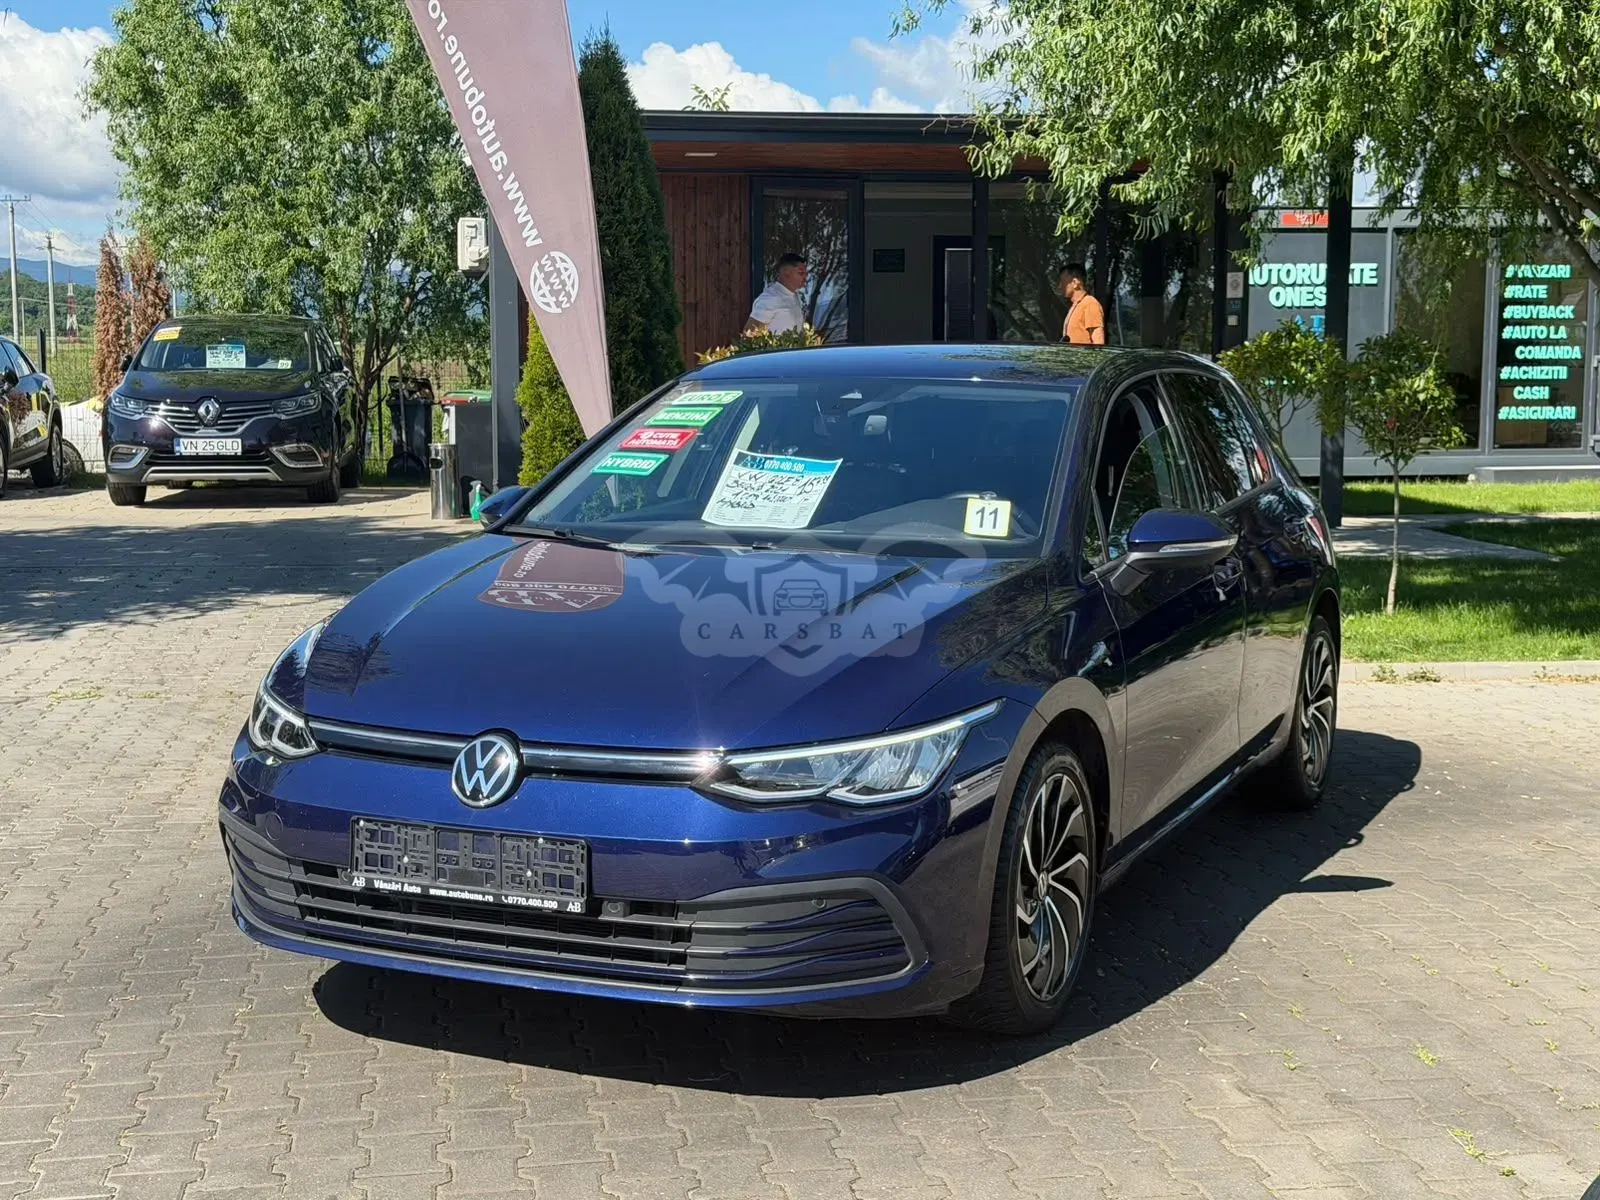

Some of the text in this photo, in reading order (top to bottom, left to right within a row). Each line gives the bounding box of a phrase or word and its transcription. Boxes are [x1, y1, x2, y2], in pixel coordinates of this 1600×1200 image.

[1248, 263, 1379, 285] UTORUTE
[1503, 285, 1549, 299] #RATE
[1502, 305, 1576, 319] #BUYBACK
[1501, 325, 1568, 340] #AUTO LA
[1514, 345, 1582, 360] COMANDA
[1499, 365, 1568, 380] #ACHIZITII
[1513, 386, 1551, 400] CASH
[1497, 406, 1577, 420] #ASIGURARI
[182, 440, 240, 451] VN 25 GLD
[602, 457, 658, 470] HYBRID
[975, 506, 999, 530] 11
[403, 883, 422, 894] Auto
[429, 887, 494, 902] www.autobune.ro
[507, 896, 558, 909] 0770.400.500
